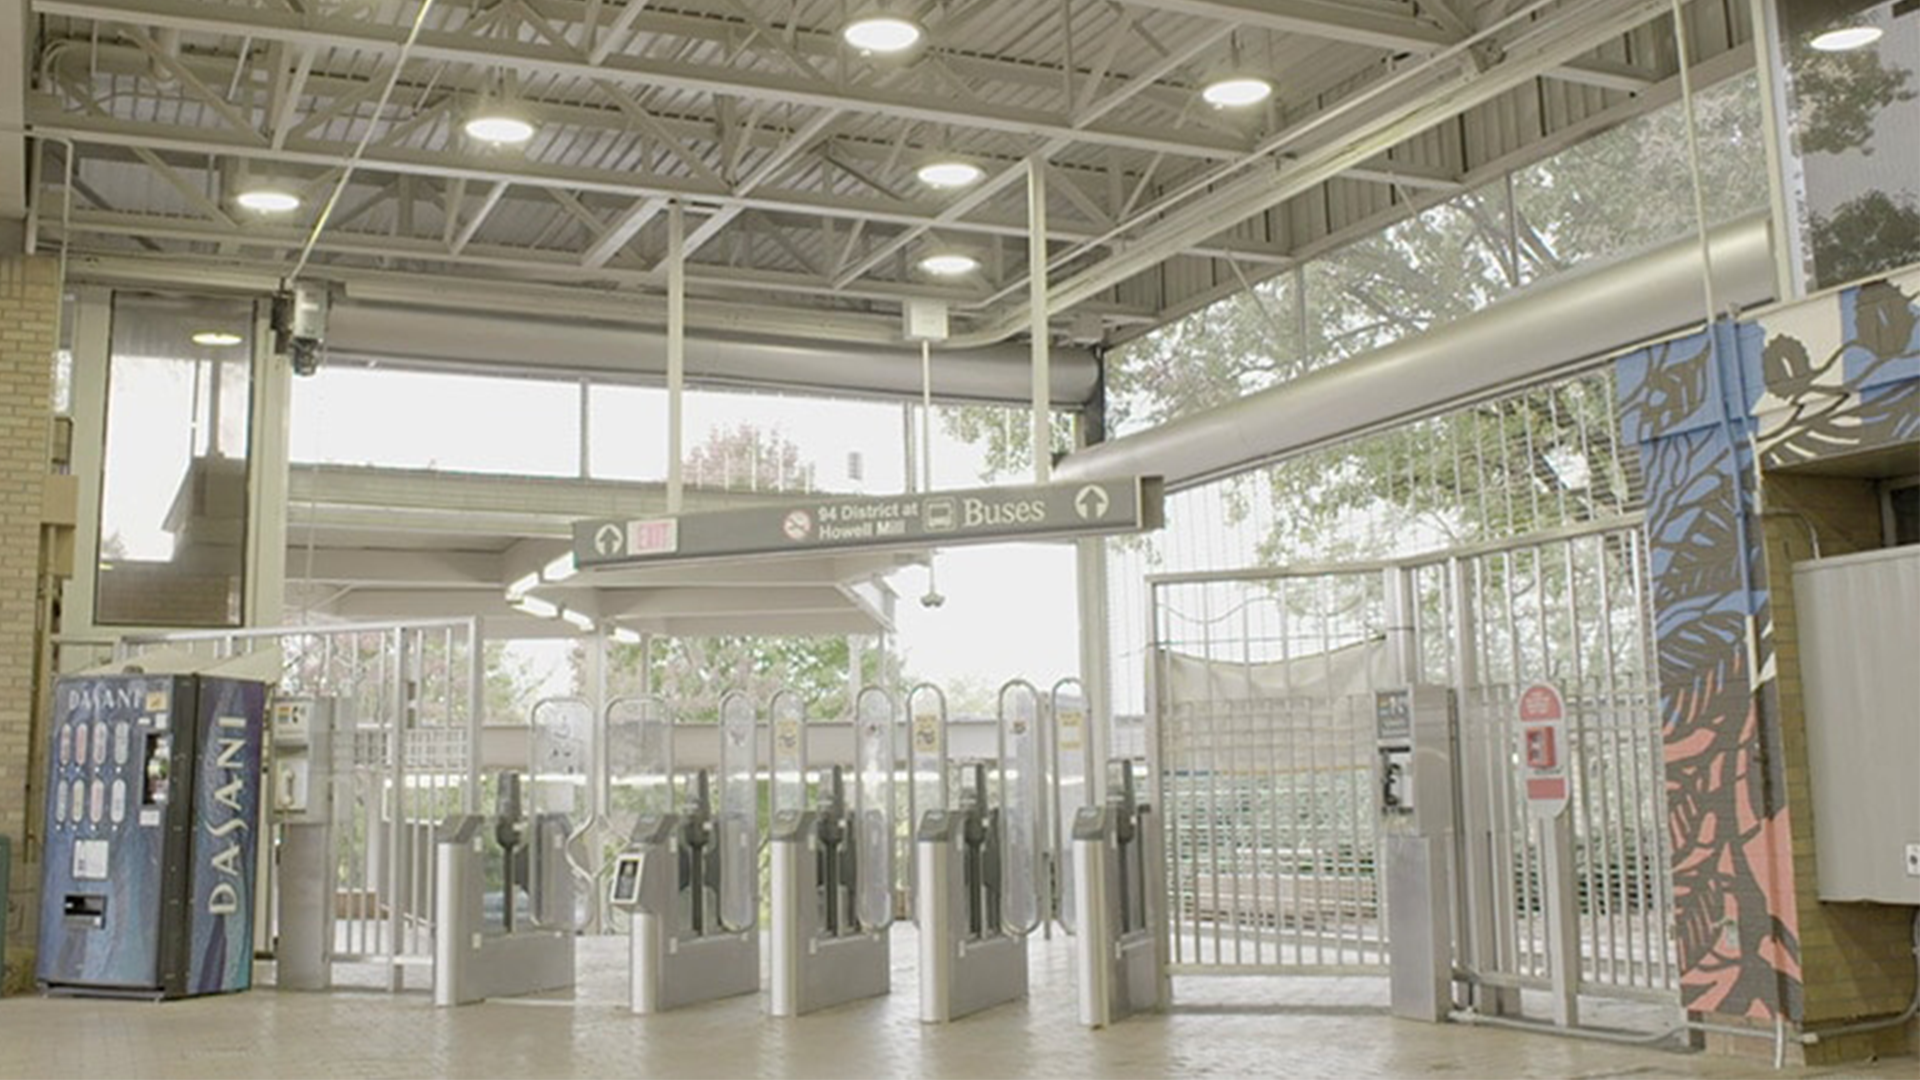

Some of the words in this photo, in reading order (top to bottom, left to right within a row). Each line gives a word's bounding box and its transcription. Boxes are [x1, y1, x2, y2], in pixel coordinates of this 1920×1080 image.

[841, 502, 899, 520] District
[901, 502, 919, 517] at
[963, 498, 1046, 528] Buses
[637, 522, 672, 550] EXIT
[819, 521, 873, 540] Howell
[876, 520, 905, 536] Mill
[69, 686, 142, 713] DASANI
[207, 716, 248, 914] DASANI
